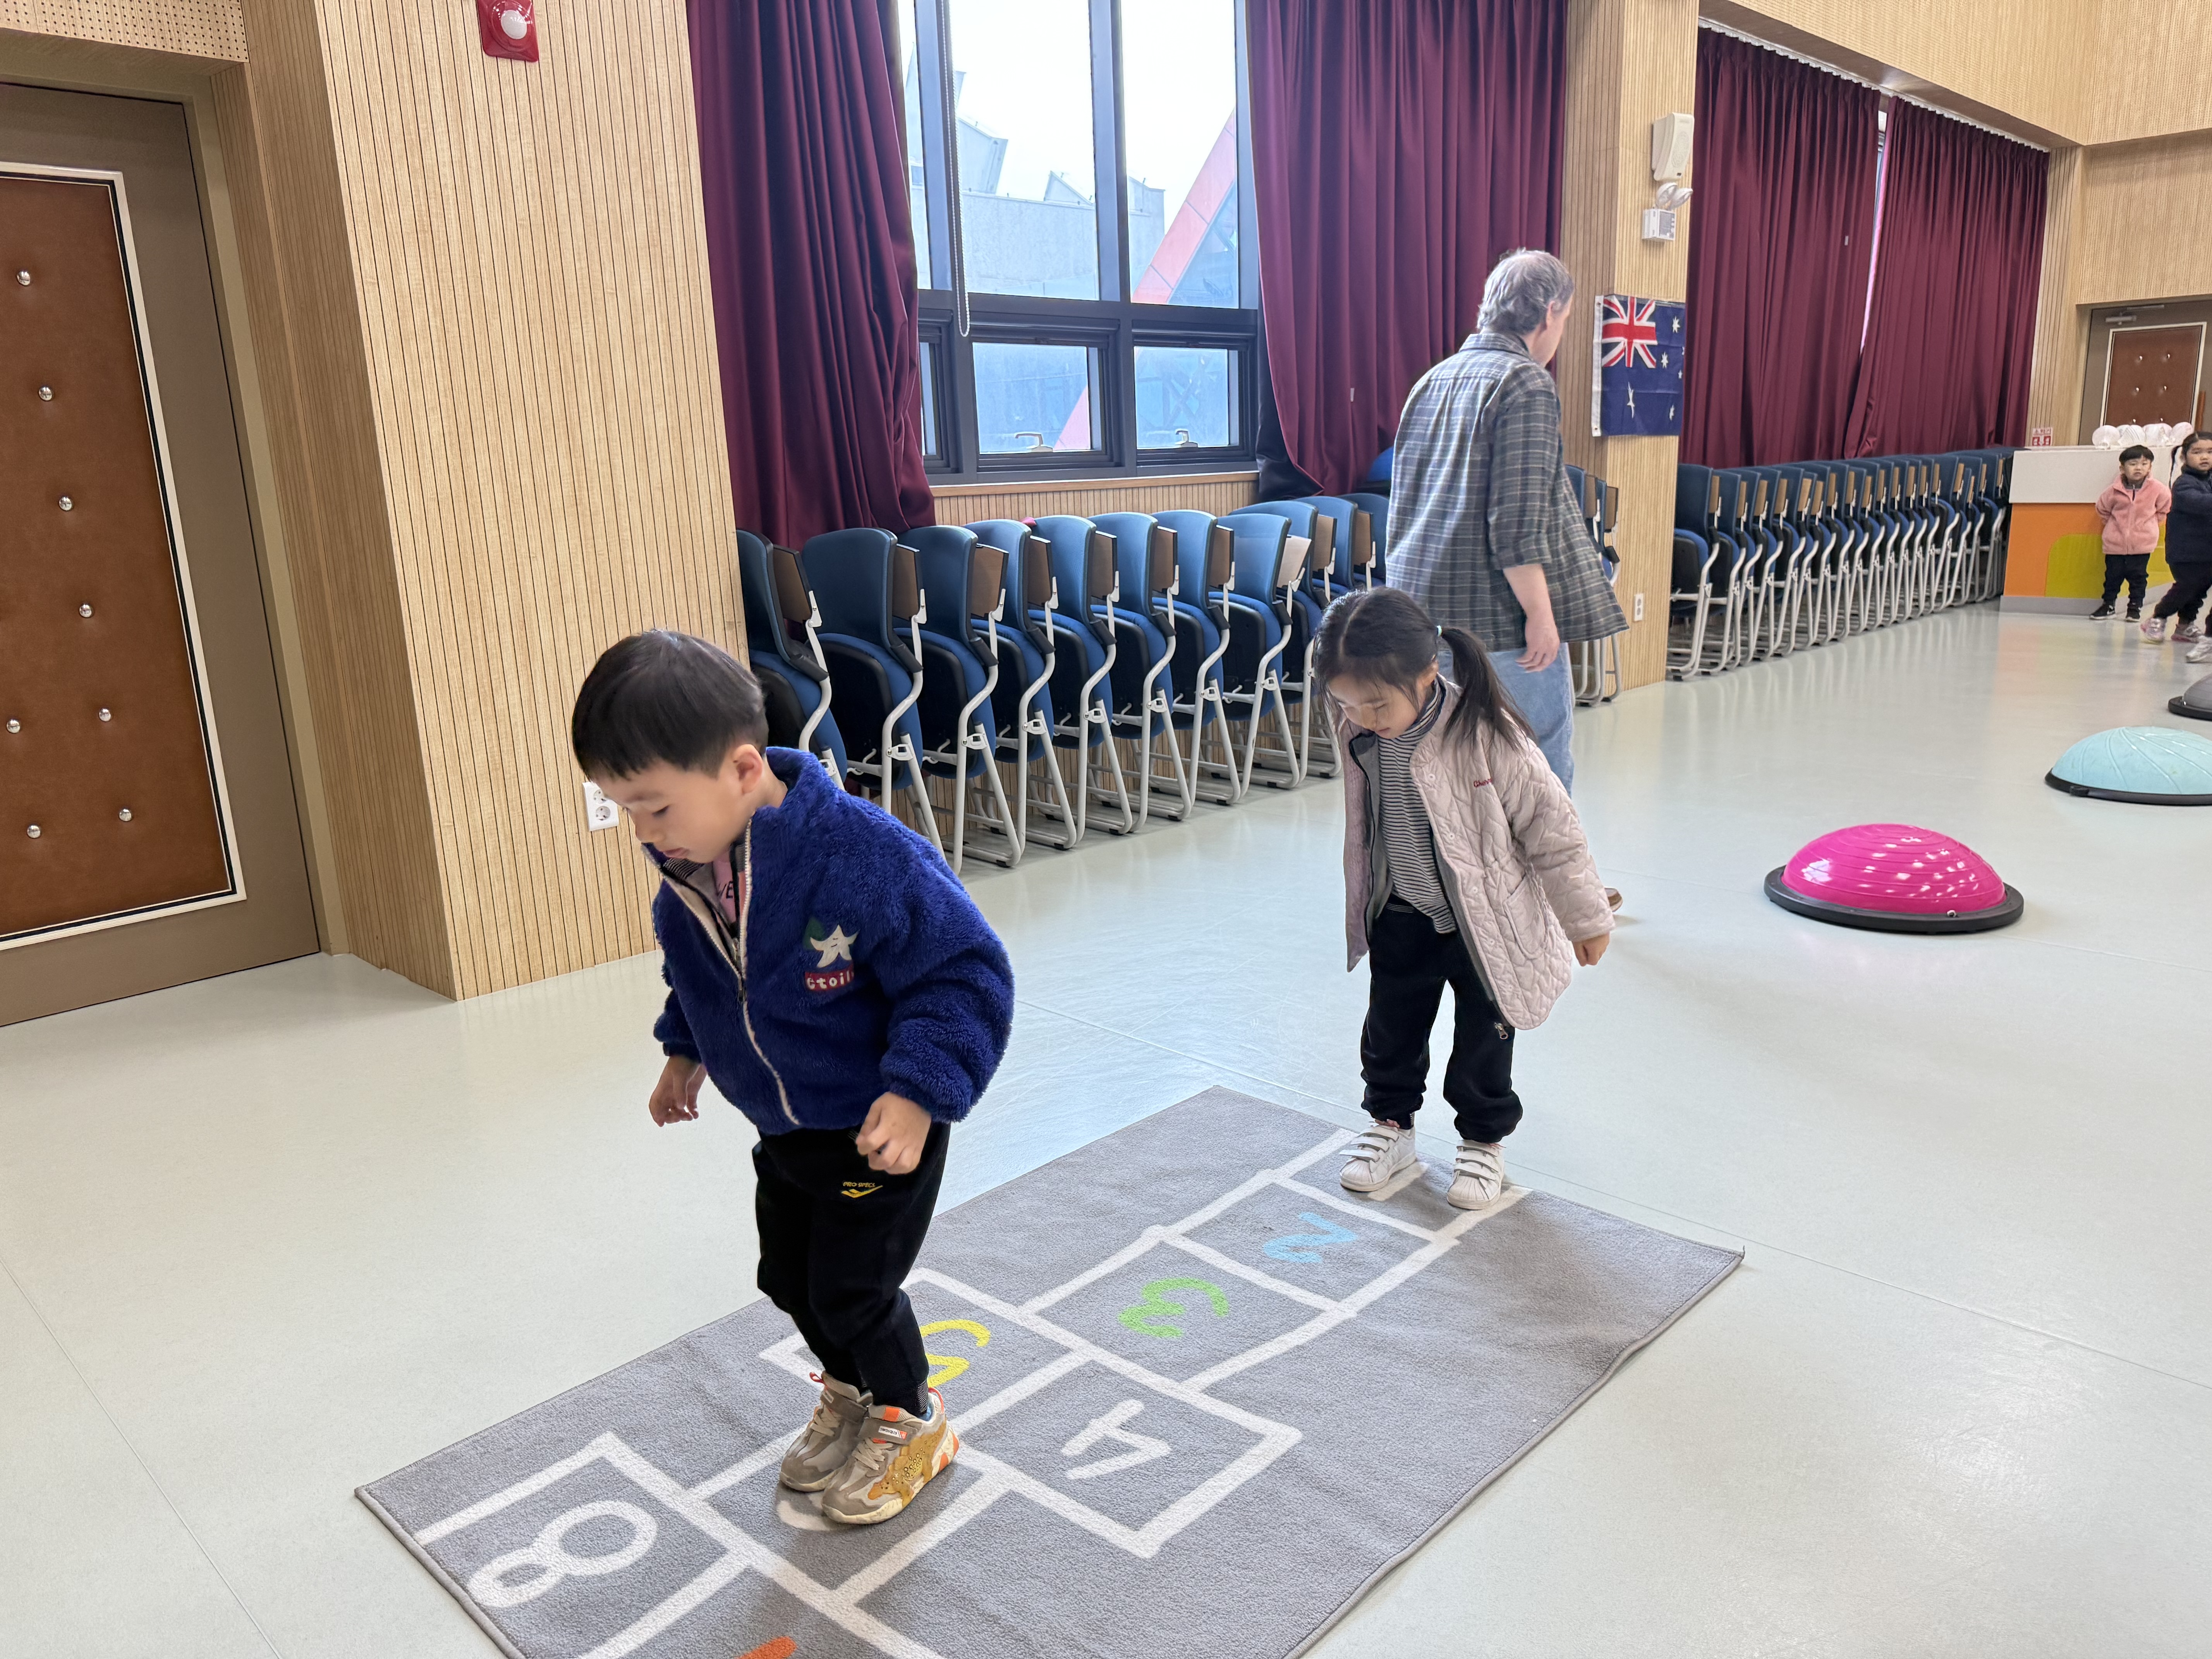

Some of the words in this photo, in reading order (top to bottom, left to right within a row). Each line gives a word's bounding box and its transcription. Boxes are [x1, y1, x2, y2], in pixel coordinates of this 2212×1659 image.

[1263, 1212, 1356, 1264] 2
[1118, 1277, 1230, 1338] 3
[1060, 1398, 1170, 1480] 4
[467, 1500, 659, 1607] 8
